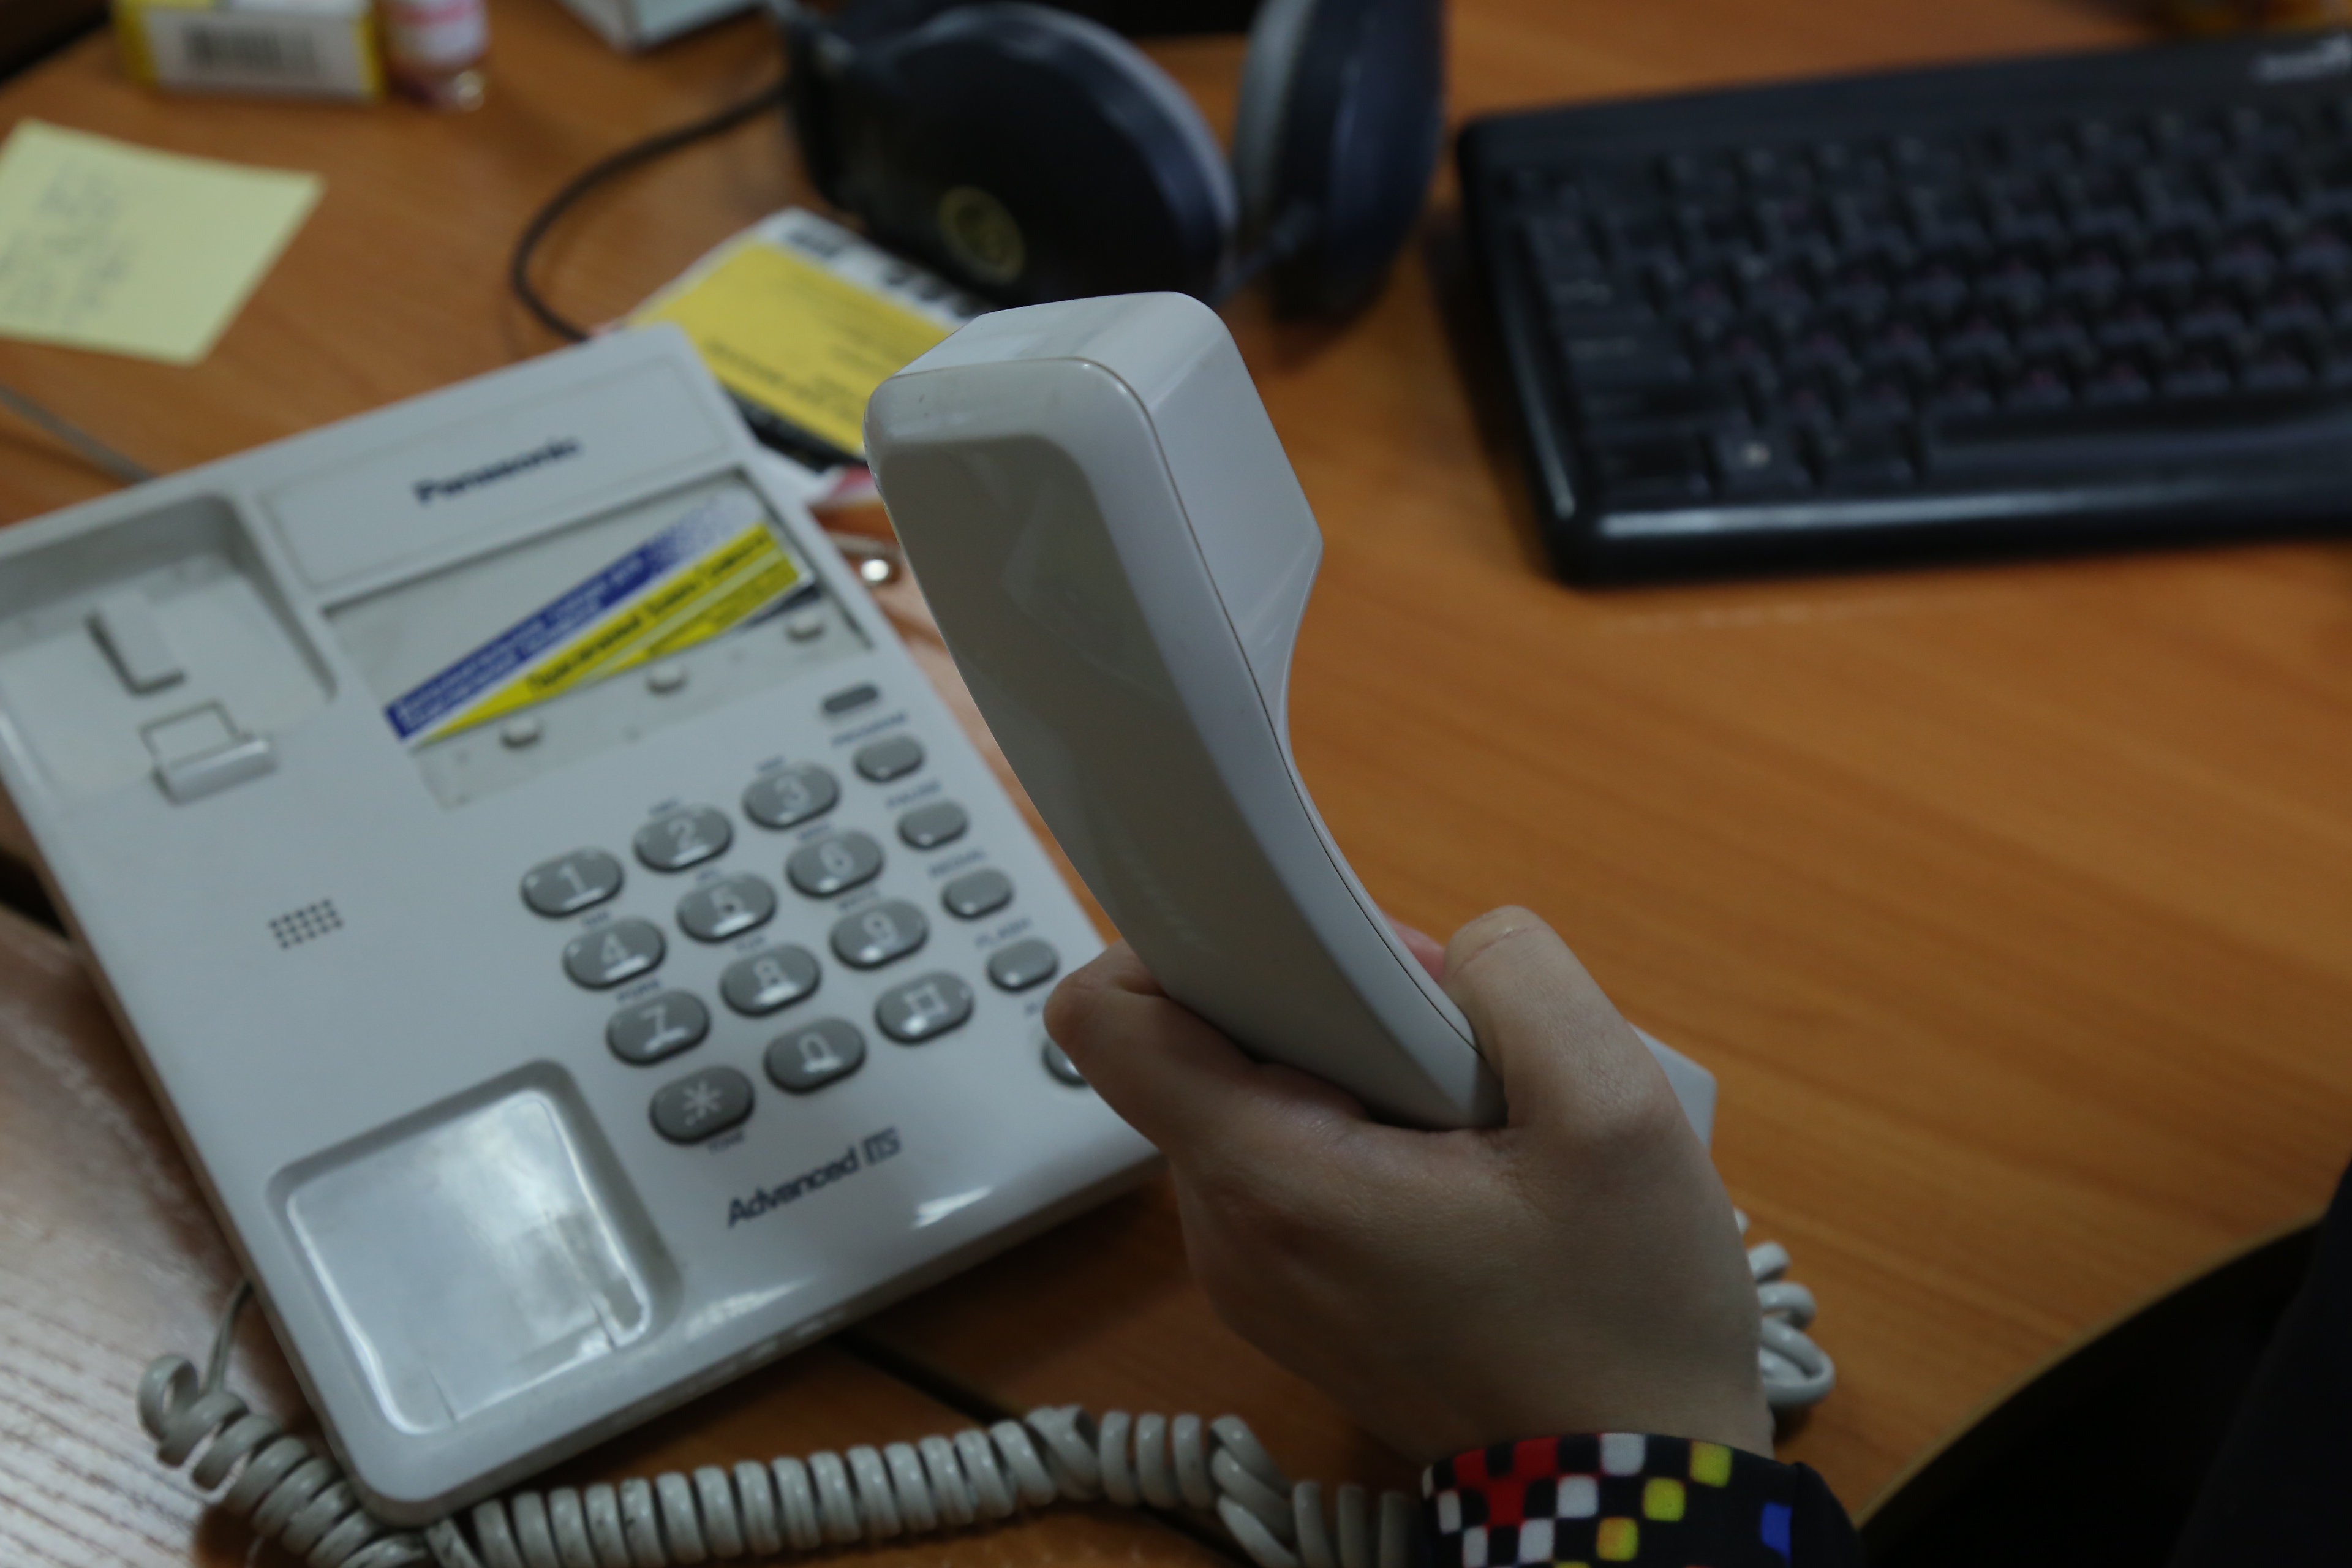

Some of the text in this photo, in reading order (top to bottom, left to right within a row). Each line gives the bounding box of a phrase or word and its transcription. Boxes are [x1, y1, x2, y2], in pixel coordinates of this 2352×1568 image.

[415, 437, 579, 505] Panasonic
[774, 774, 811, 818] 3
[666, 815, 704, 859] 2
[560, 861, 603, 903] 1
[820, 839, 855, 883] 6
[710, 886, 745, 926] 5
[600, 932, 635, 975] 4
[861, 911, 899, 954] 9
[753, 957, 793, 997] 8
[642, 1005, 677, 1045] 7
[797, 1031, 838, 1071] 0
[728, 1145, 860, 1227] Advanced
